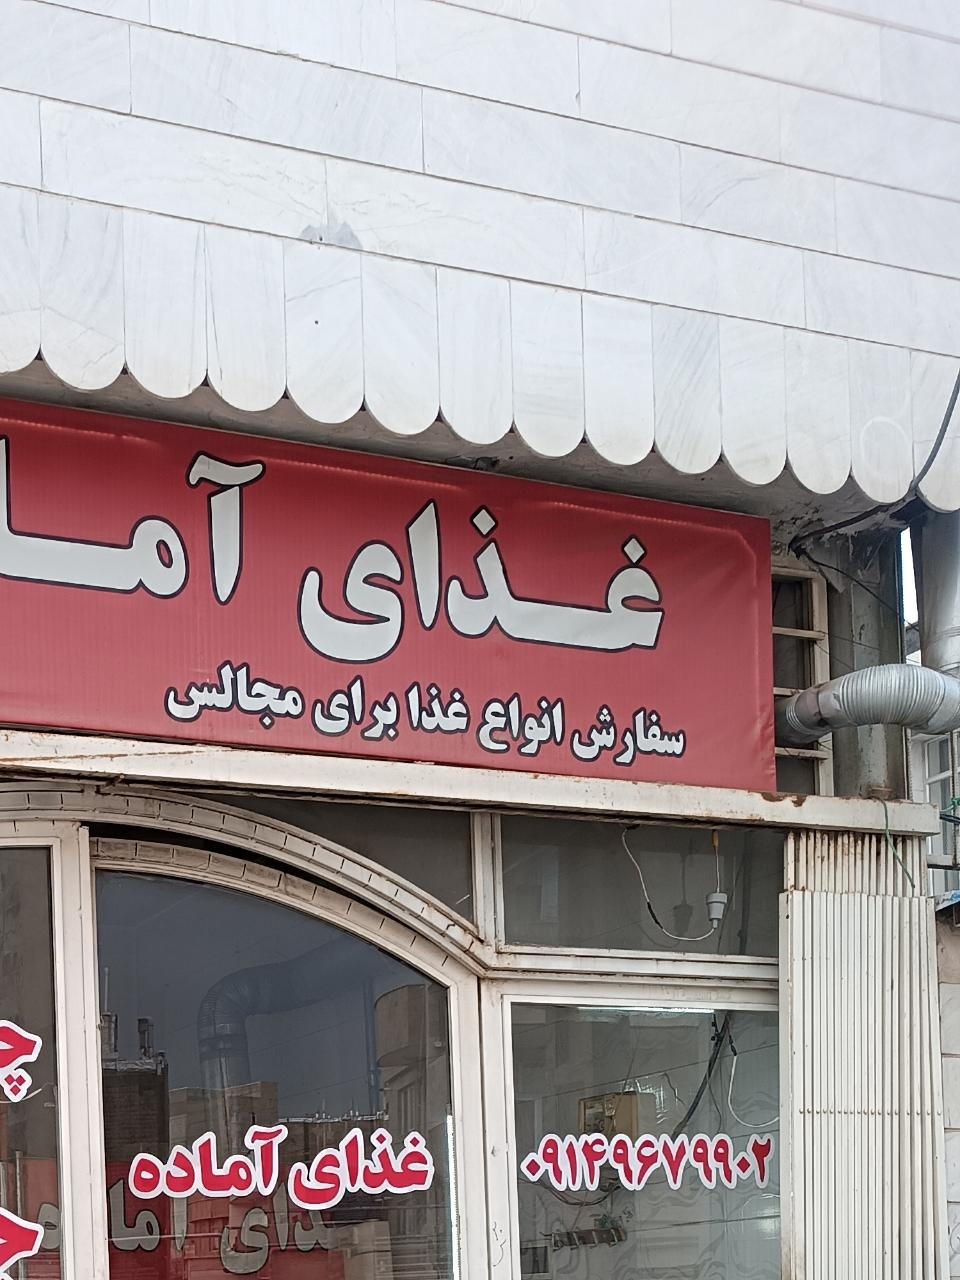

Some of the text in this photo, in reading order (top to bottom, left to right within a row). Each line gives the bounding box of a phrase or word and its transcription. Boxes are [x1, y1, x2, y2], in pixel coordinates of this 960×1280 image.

[298, 500, 664, 663] غذای
[164, 660, 686, 767] سفارش انواع غذا برای مجالس
[128, 1124, 435, 1210] غذای آماده
[520, 1133, 775, 1190] ۰۹۱۴۹۶۷۹۹۰۲
